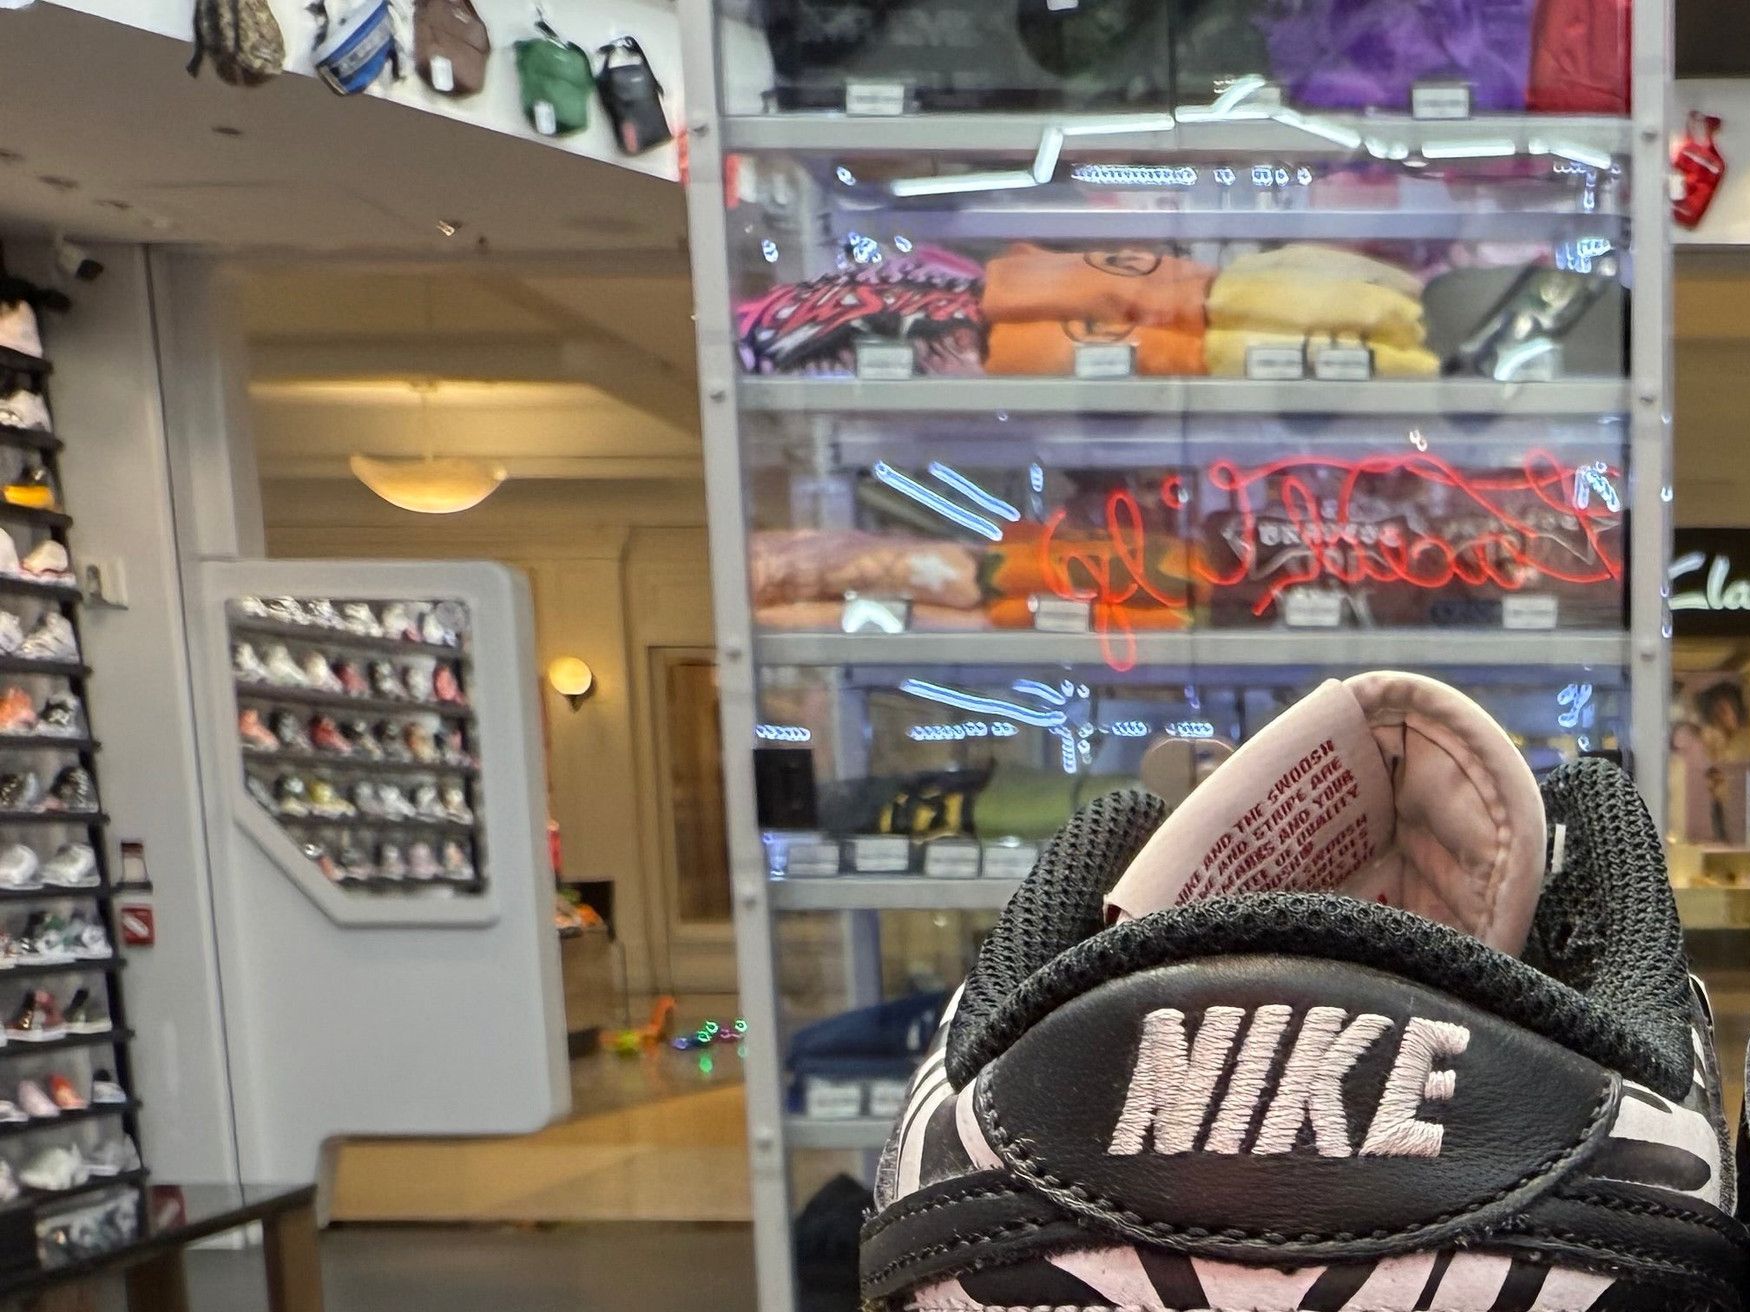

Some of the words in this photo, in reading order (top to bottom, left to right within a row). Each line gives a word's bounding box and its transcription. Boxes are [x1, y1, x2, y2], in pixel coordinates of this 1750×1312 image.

[1203, 832, 1233, 871] AND
[1267, 739, 1336, 803] SWOOSH
[1312, 767, 1357, 810] YOUR
[1106, 1003, 1472, 1159] NIKE
